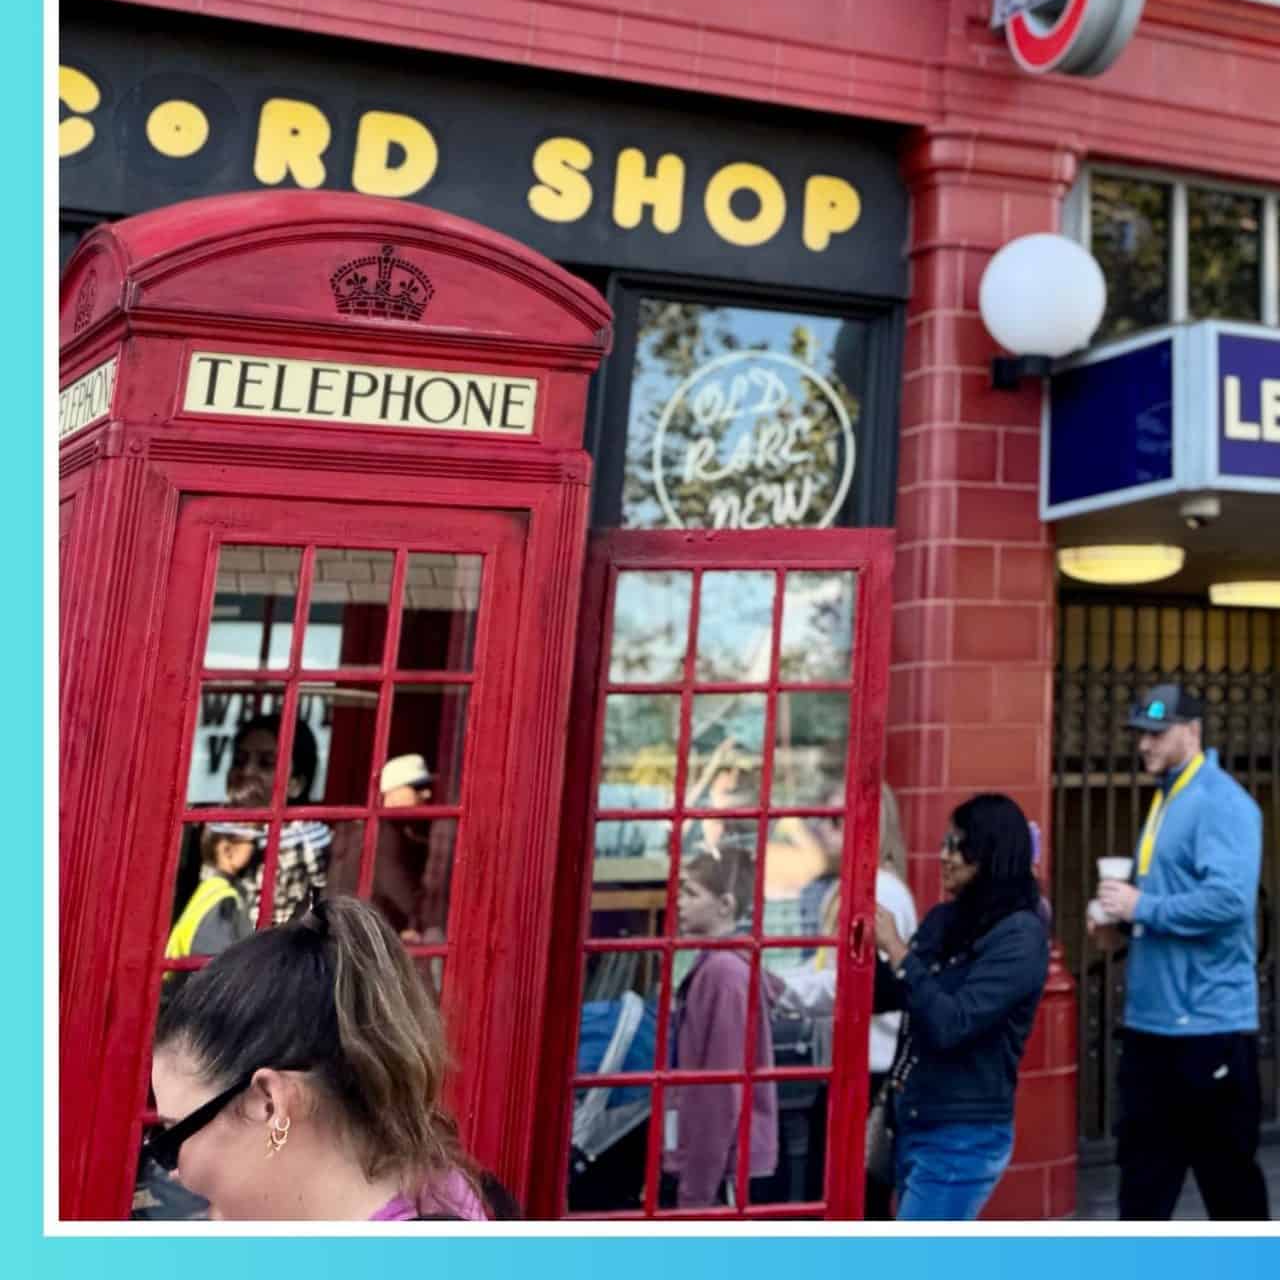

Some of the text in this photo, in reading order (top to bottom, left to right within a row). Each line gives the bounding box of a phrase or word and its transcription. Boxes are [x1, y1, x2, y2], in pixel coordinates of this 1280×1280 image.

[528, 136, 861, 252] SHOP
[197, 356, 531, 429] TELEPHONE
[692, 367, 788, 426] OLD
